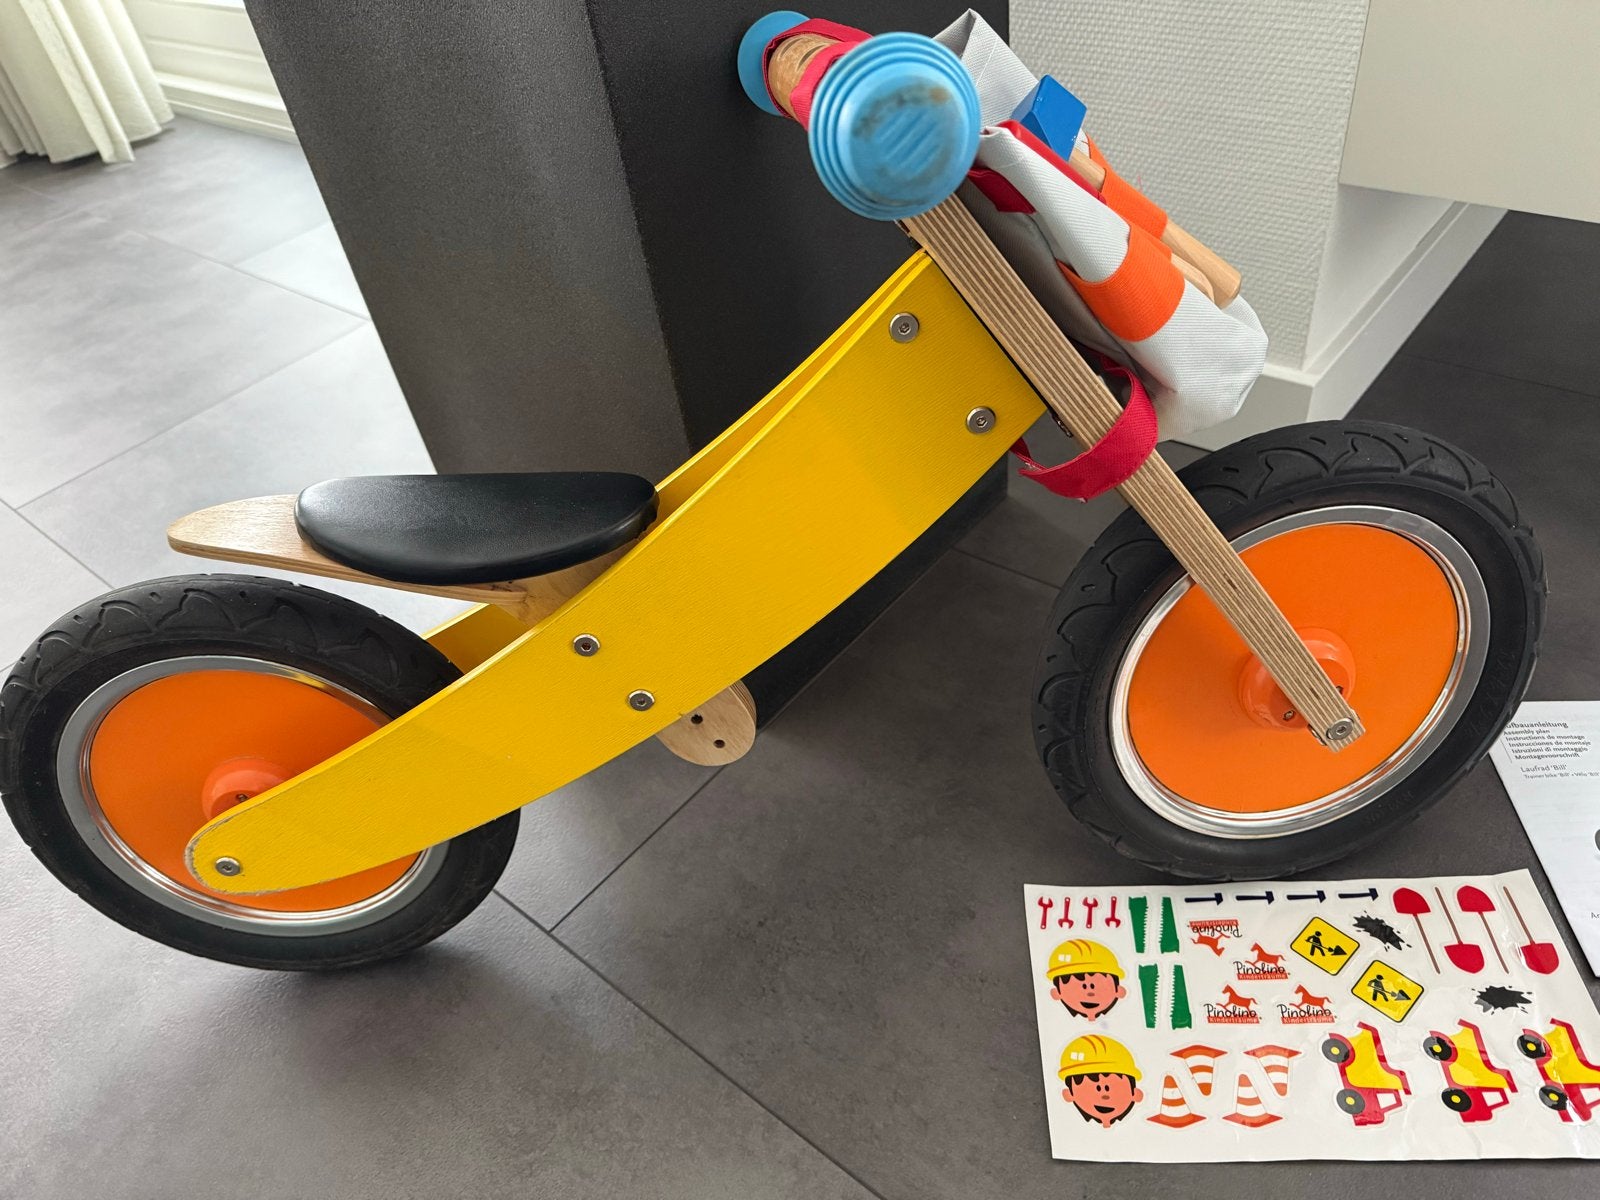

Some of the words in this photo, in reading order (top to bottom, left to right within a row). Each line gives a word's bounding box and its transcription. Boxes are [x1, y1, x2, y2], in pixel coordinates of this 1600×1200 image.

[1192, 925, 1242, 938] Pinolino
[1233, 961, 1285, 974] Pinolino
[1204, 1003, 1257, 1018] Pinolino
[1277, 1003, 1332, 1018] Pinolino
